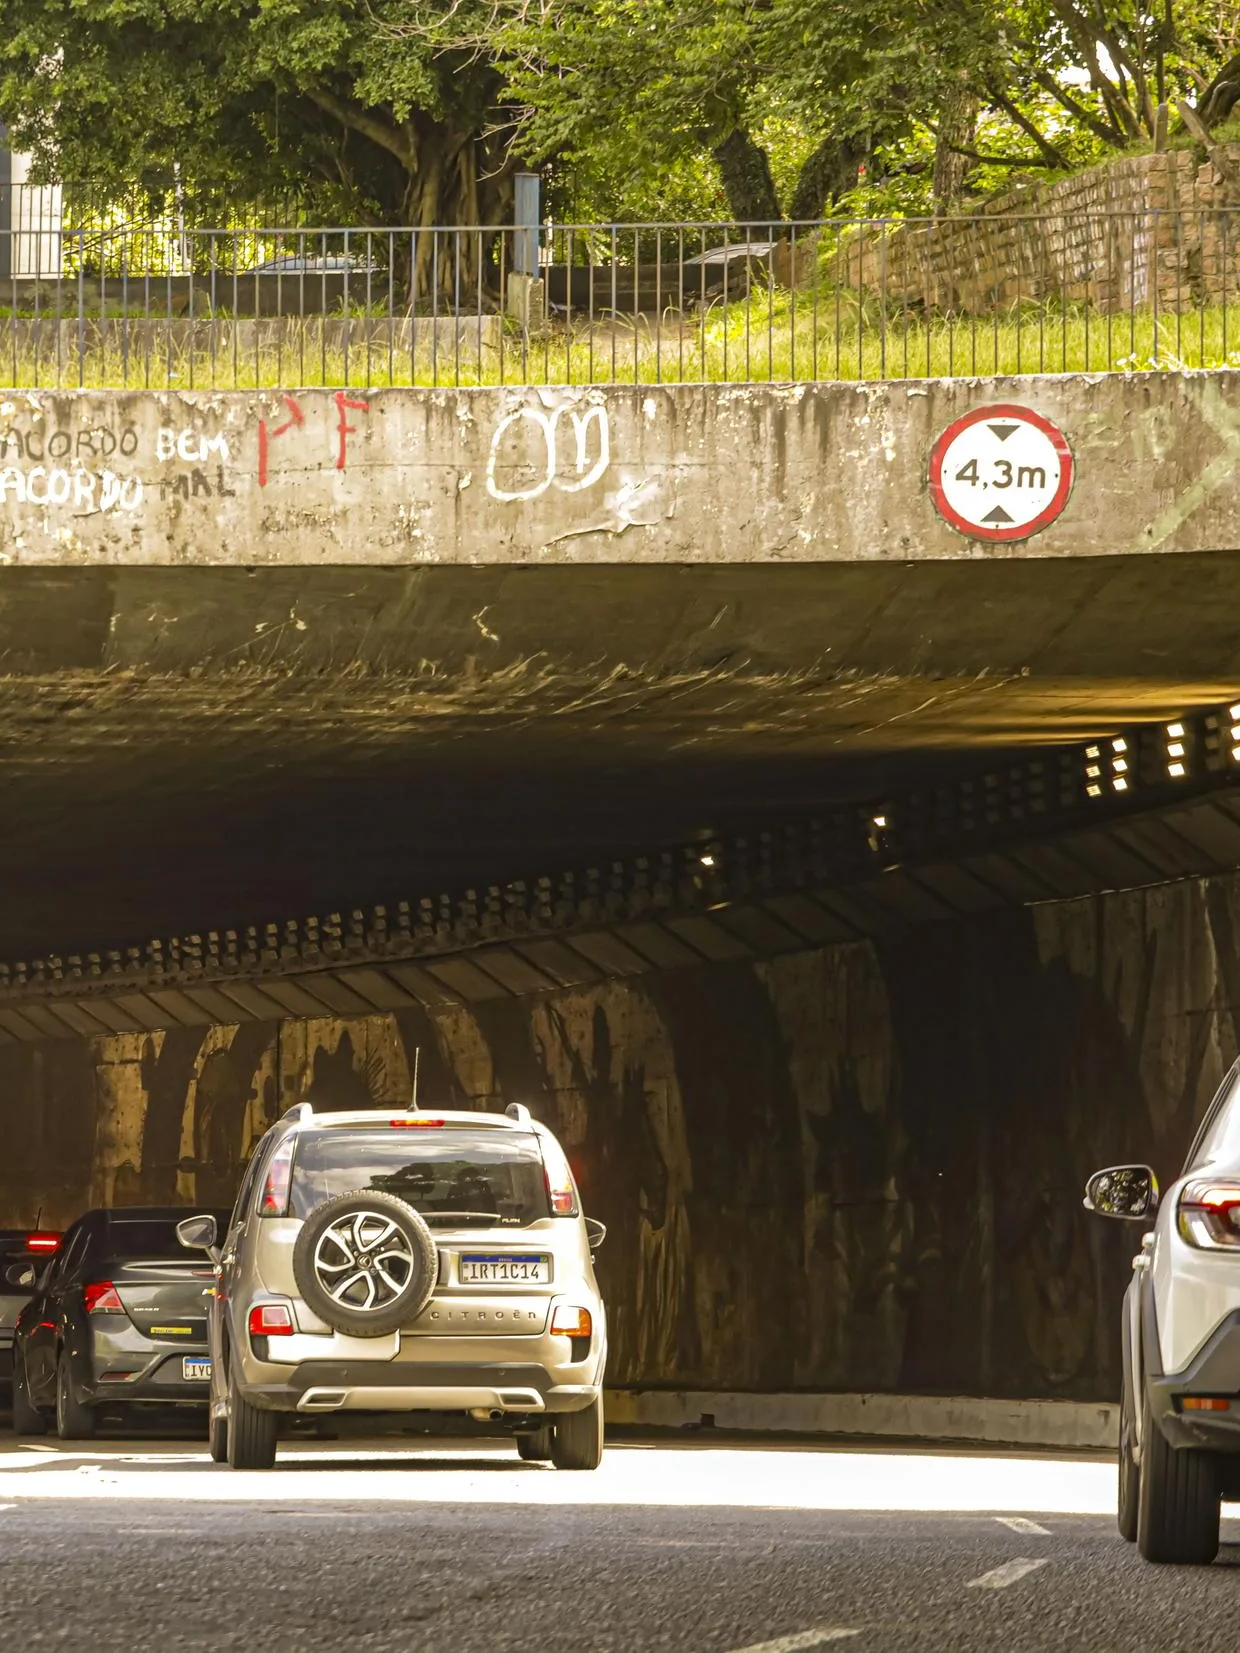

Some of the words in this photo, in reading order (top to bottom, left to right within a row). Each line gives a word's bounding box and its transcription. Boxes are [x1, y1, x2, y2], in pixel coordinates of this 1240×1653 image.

[0, 426, 138, 464] ACORDO
[156, 428, 230, 462] BEM
[160, 465, 236, 500] MAL
[955, 459, 1046, 490] 4,3m
[470, 1263, 539, 1279] IRT1C14
